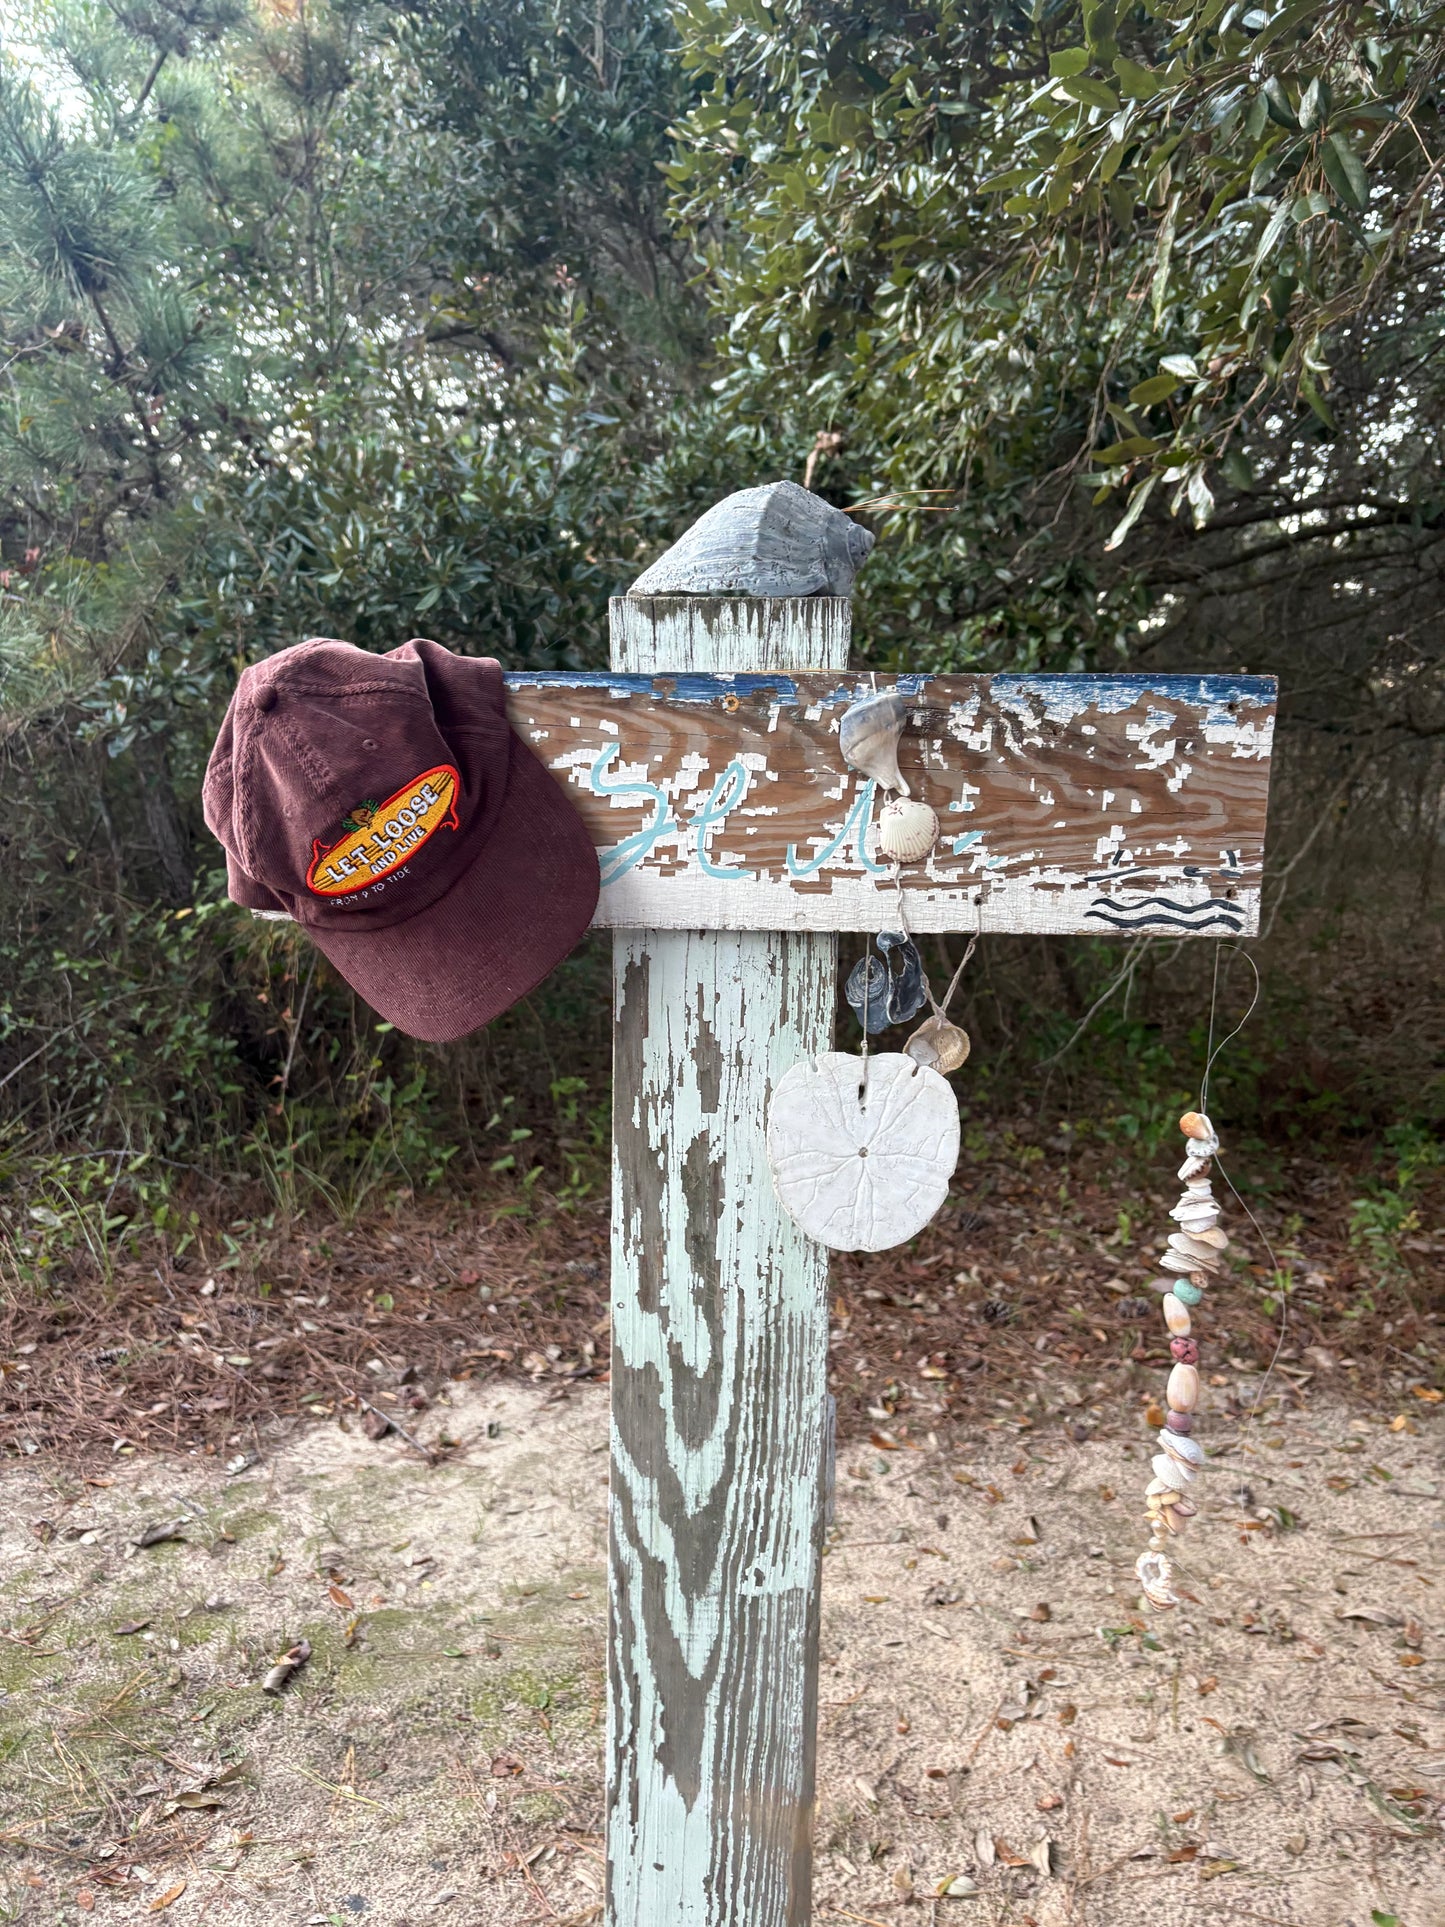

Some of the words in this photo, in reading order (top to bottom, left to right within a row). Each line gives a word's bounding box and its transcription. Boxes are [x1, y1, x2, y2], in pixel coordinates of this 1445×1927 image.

[325, 844, 371, 883] LET
[372, 784, 440, 850] LOOSE
[370, 850, 397, 875] AND
[396, 825, 427, 853] LIVE
[330, 894, 358, 906] FROM
[362, 890, 368, 898] 9
[371, 883, 385, 892] TO
[387, 866, 411, 883] TIDE
